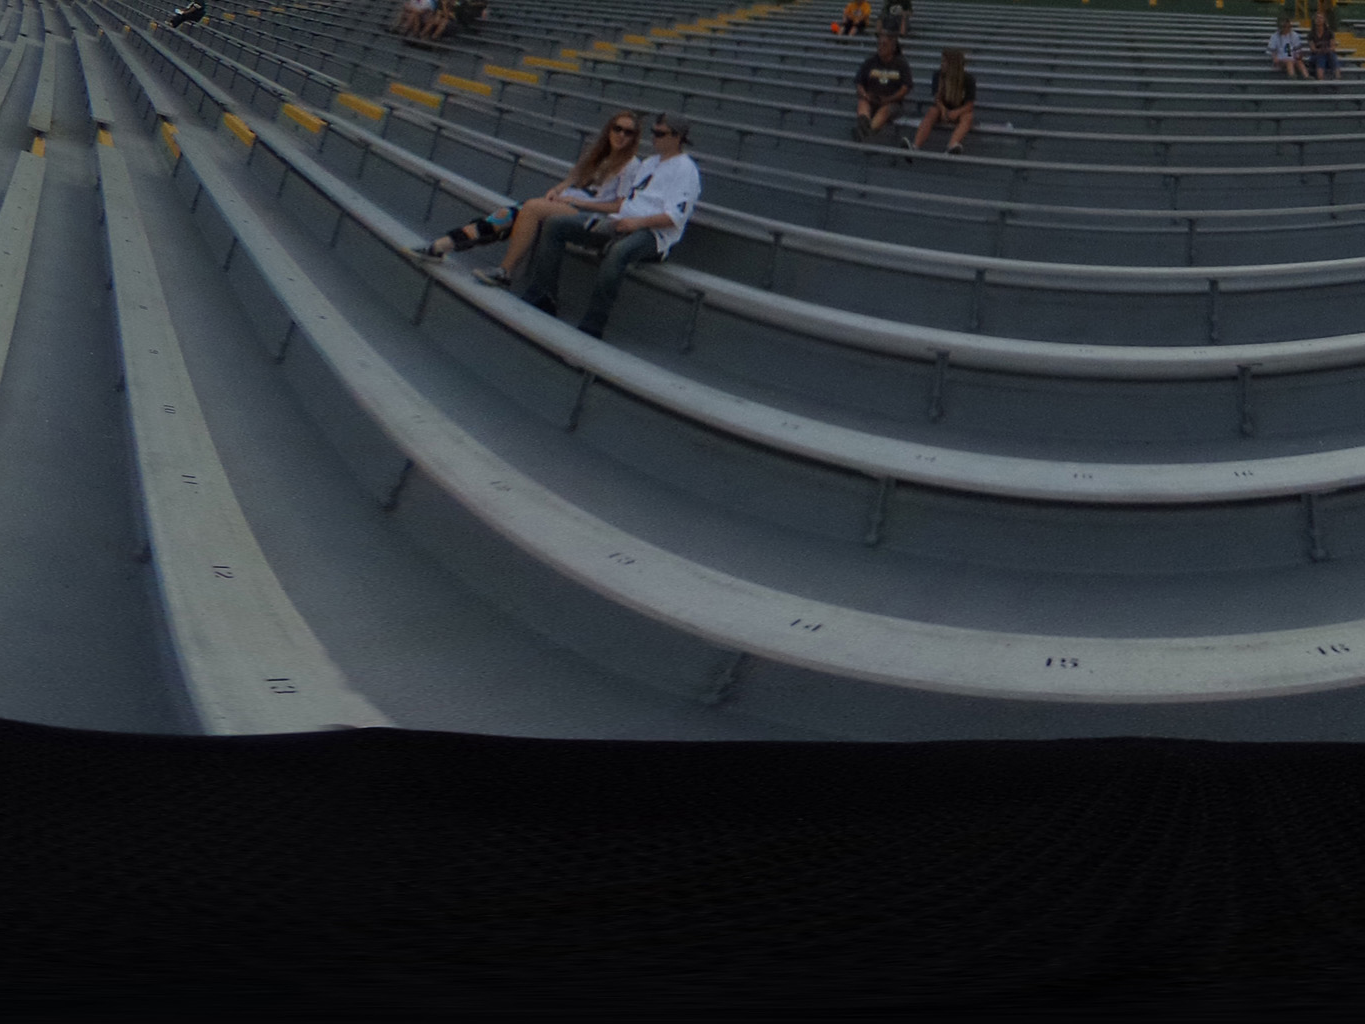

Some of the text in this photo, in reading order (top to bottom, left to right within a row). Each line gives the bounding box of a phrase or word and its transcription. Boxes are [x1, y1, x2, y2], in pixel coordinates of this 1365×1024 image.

[212, 566, 233, 578] 12
[1046, 658, 1078, 667] 15
[266, 678, 296, 694] 13
